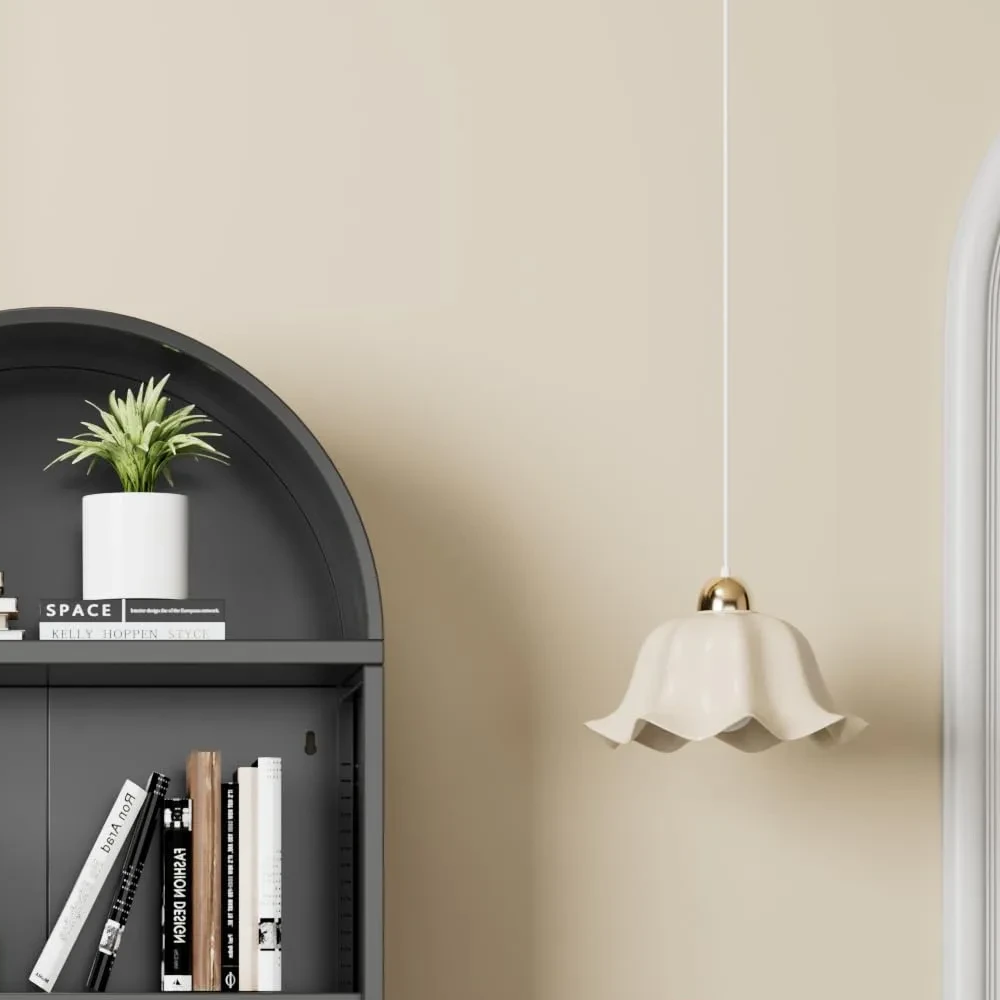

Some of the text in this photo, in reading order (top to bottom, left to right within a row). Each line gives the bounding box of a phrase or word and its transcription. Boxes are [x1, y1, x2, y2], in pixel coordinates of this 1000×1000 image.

[45, 603, 112, 617] SPACE
[52, 628, 93, 639] KELLY
[103, 628, 158, 639] HOPPEN
